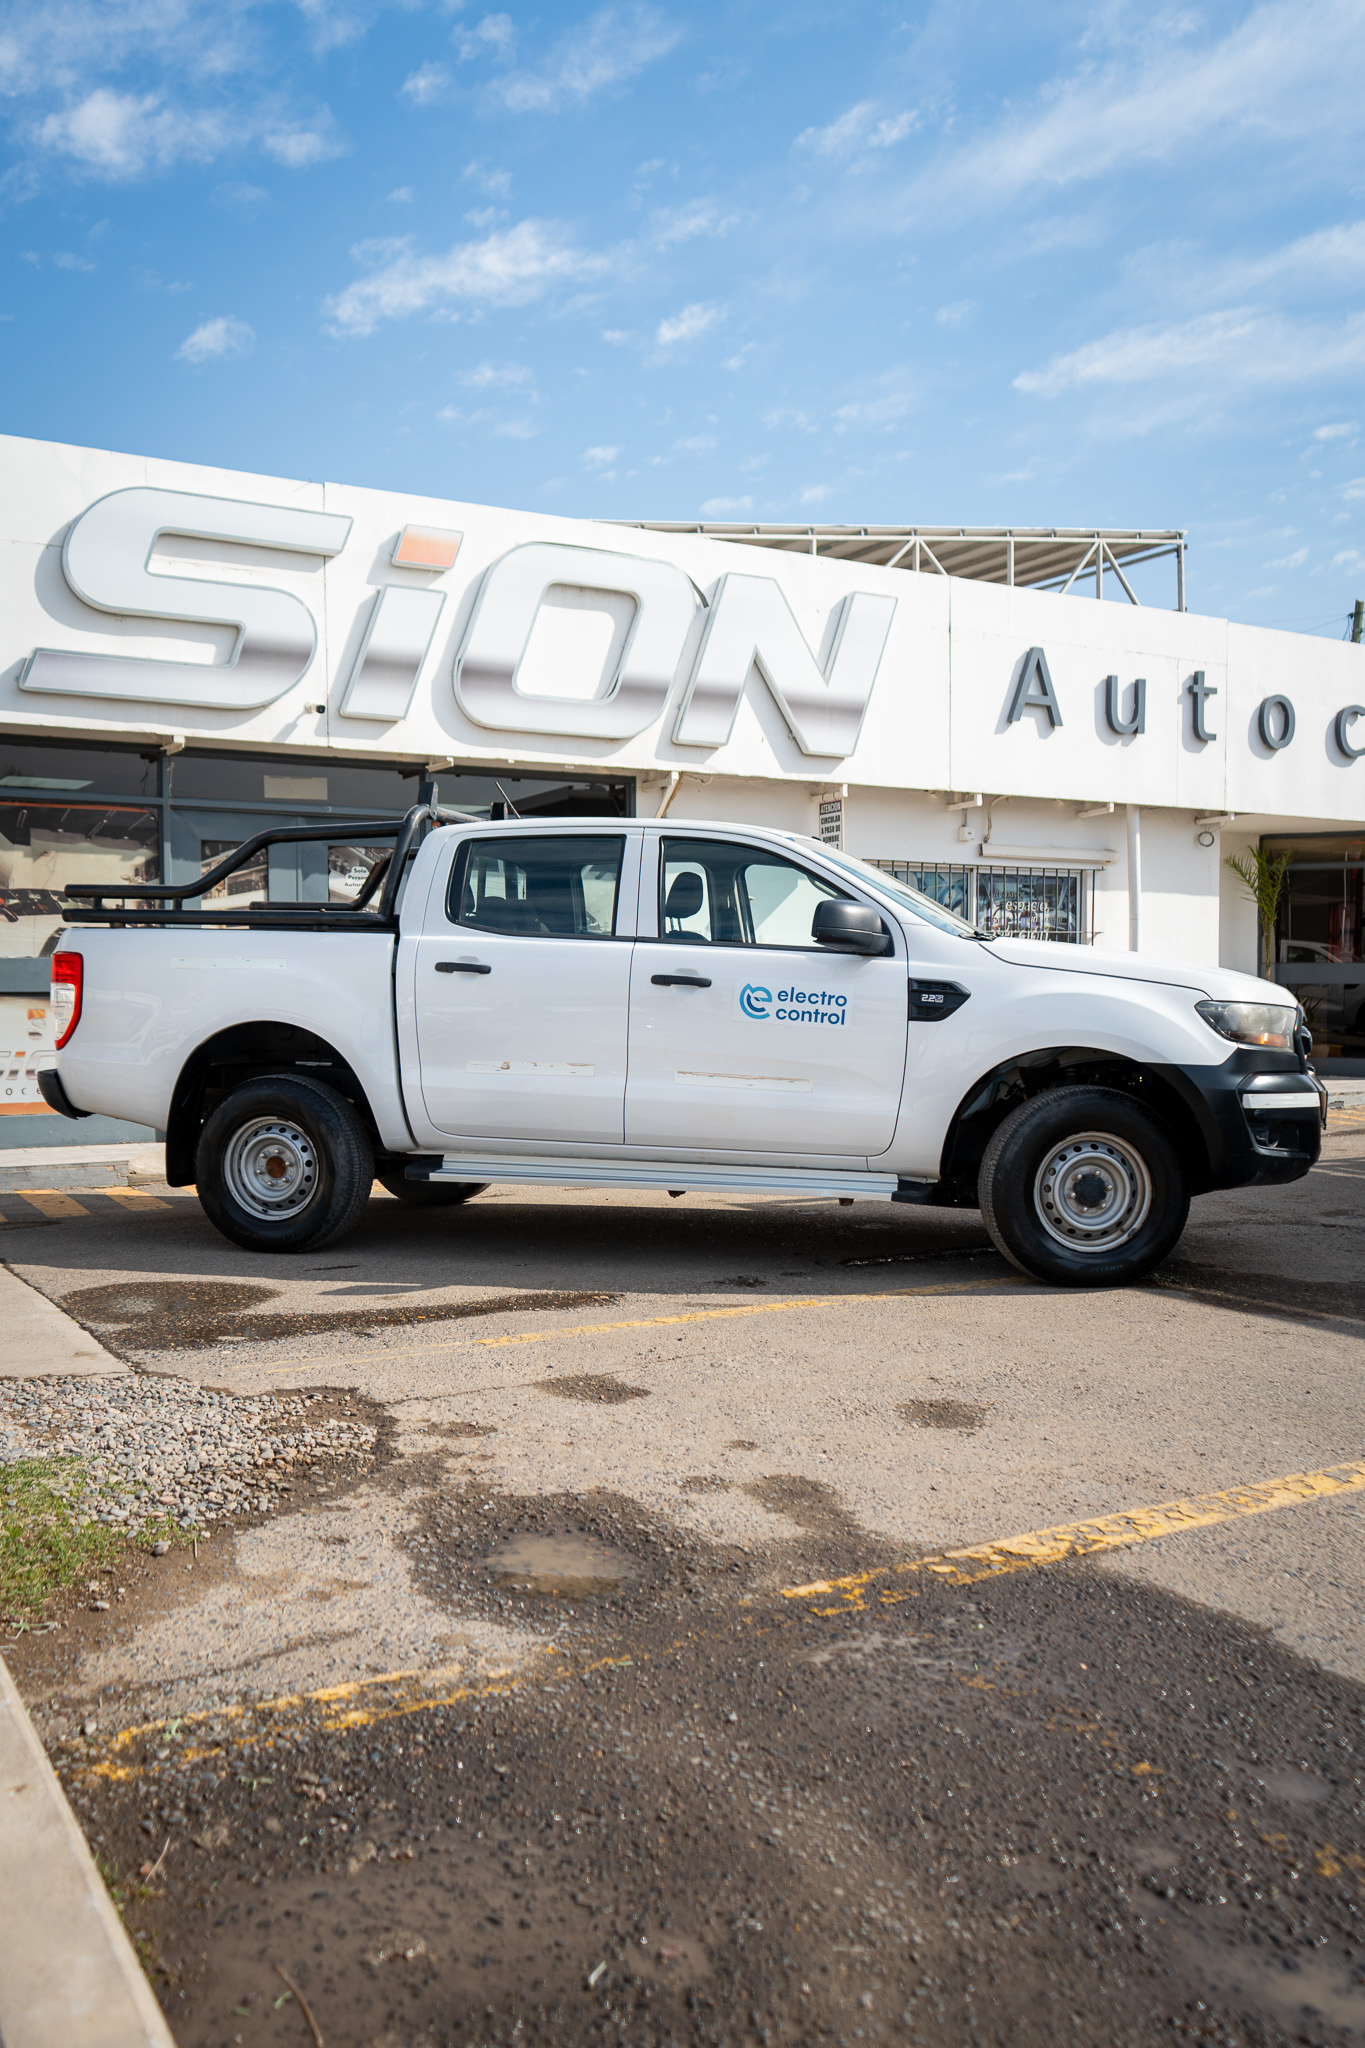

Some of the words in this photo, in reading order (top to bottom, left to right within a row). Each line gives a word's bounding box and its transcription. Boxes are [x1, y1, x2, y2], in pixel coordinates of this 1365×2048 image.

[820, 814, 841, 825] CIRCULAR
[824, 825, 835, 834] PASO
[835, 824, 841, 833] DE
[777, 986, 848, 1007] electro
[775, 1008, 846, 1026] control
